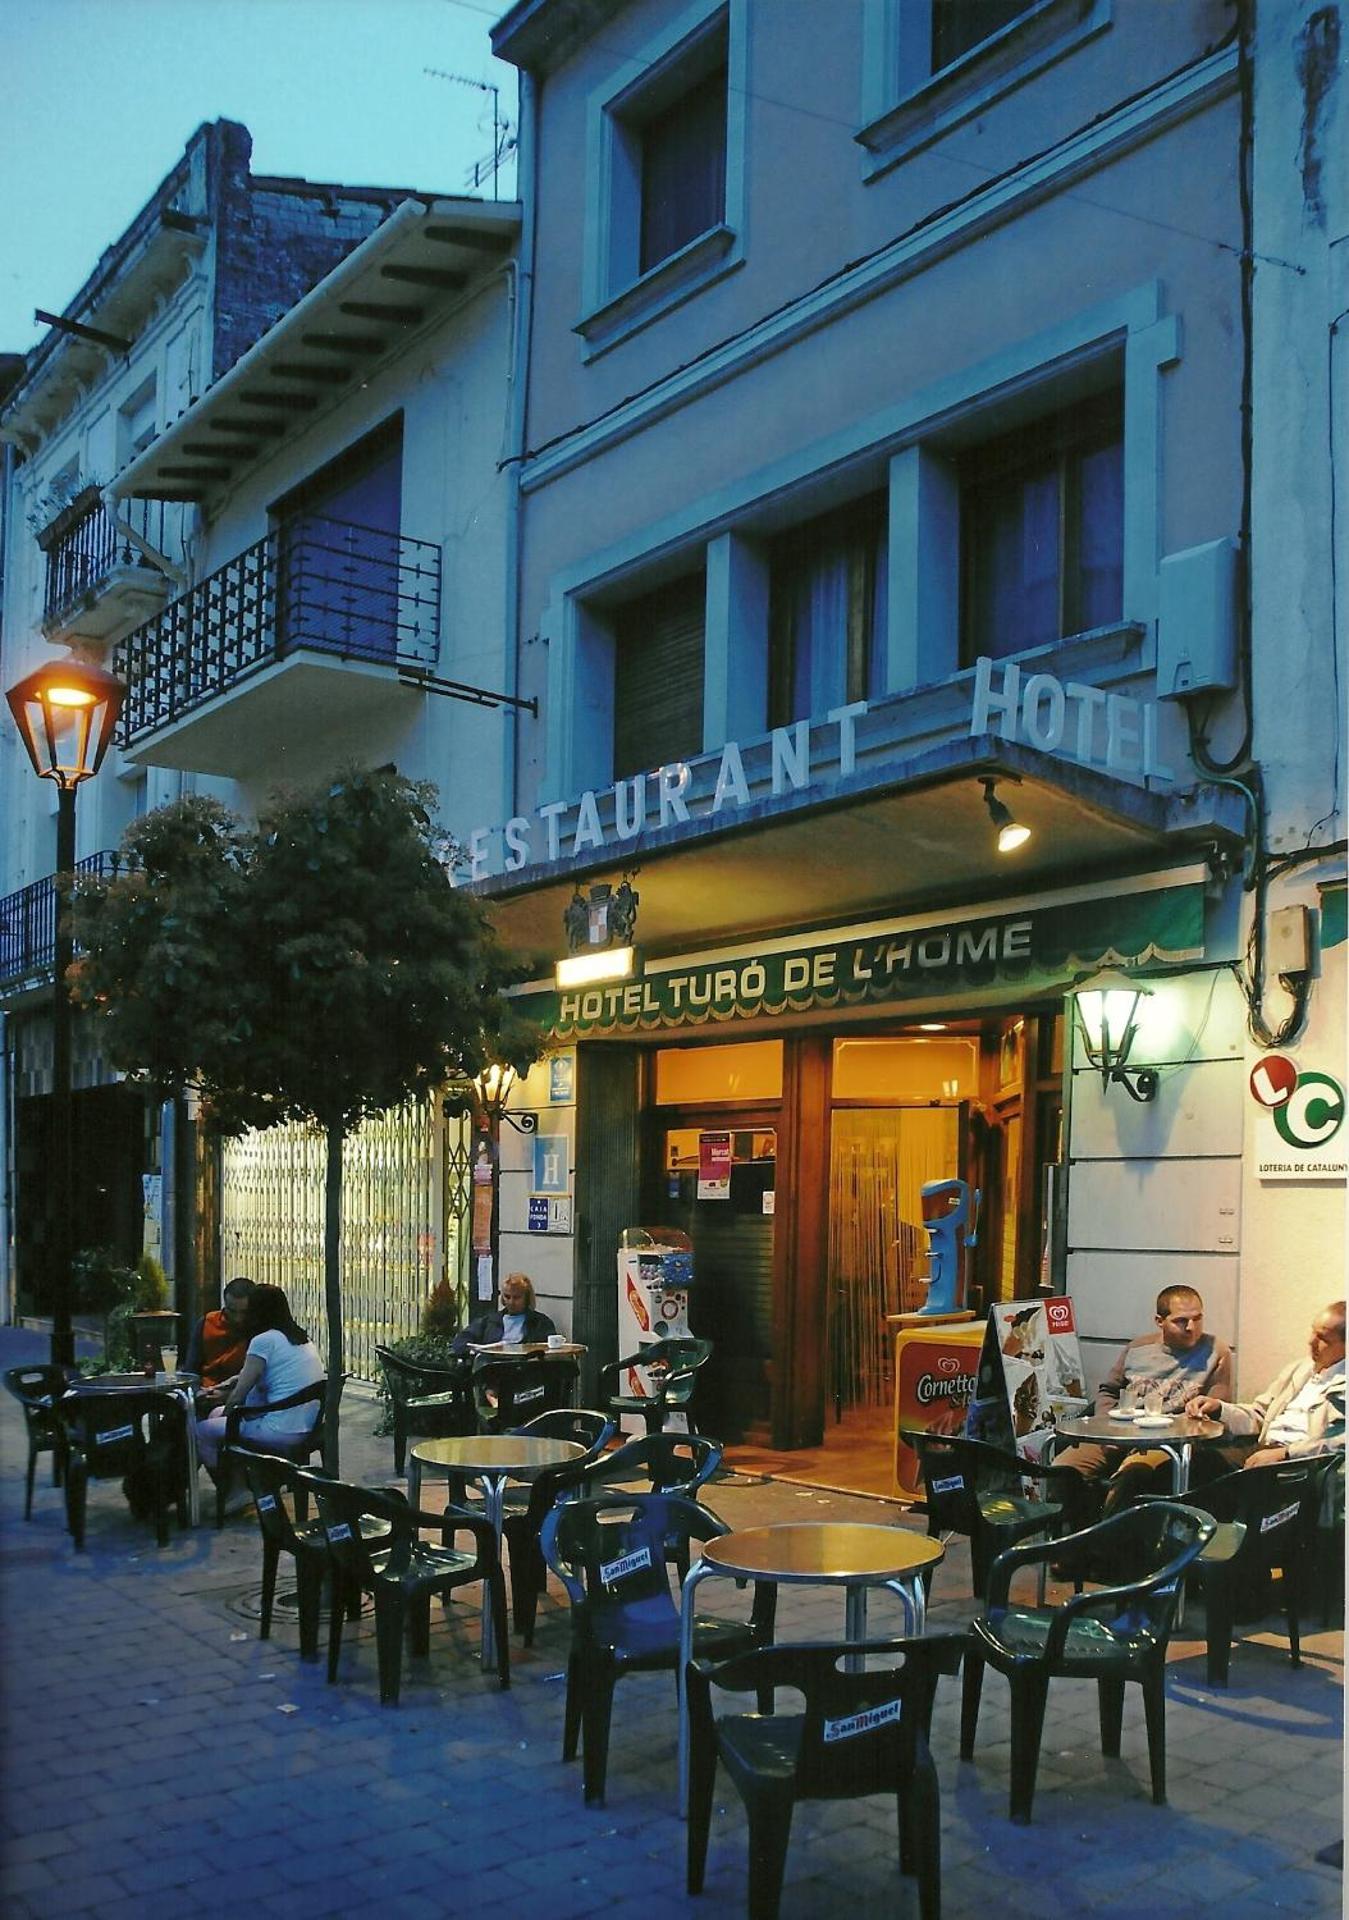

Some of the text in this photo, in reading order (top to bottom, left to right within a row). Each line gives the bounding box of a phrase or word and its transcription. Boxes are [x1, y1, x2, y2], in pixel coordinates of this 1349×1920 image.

[971, 656, 1174, 782] HOTEL
[447, 700, 868, 888] ESTAURANT
[560, 920, 1033, 1022] HOTEL TURÓ DE L'HOME
[542, 1153, 560, 1185] H
[1259, 1164, 1293, 1172] LOTERIA
[1295, 1164, 1305, 1172] DE
